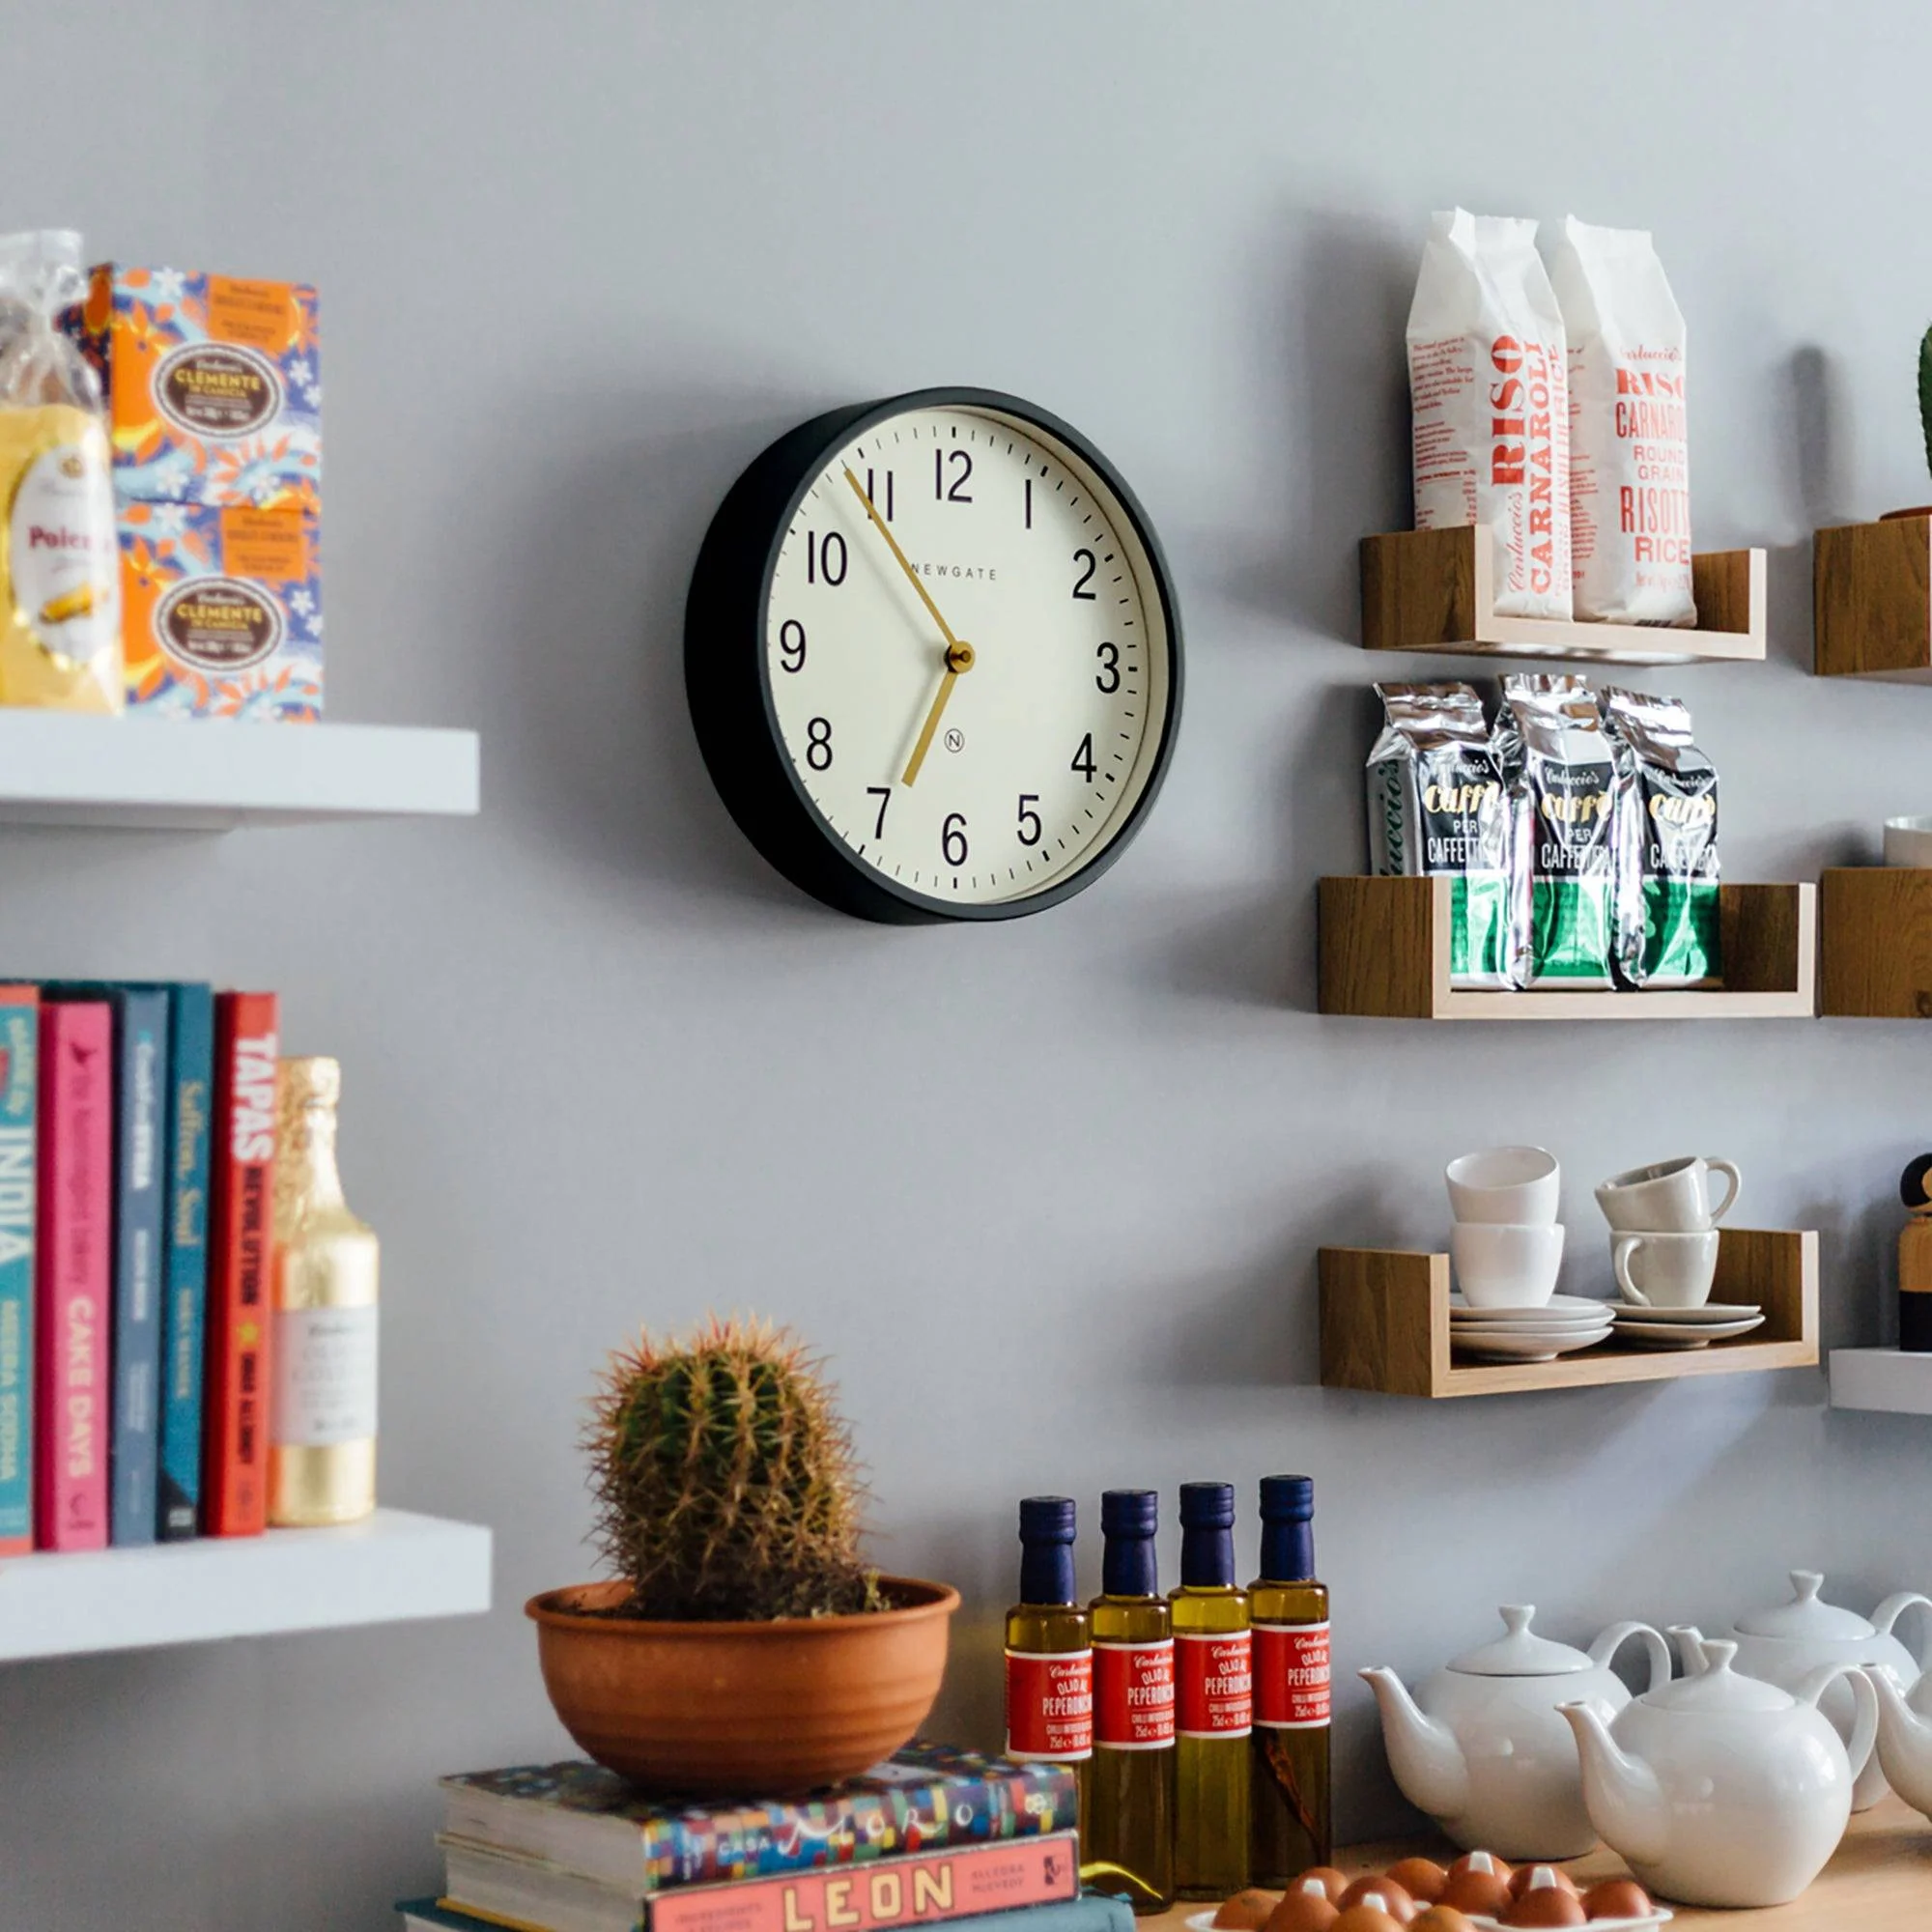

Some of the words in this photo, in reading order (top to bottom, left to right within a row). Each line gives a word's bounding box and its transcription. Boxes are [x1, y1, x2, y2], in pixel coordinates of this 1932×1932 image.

[1491, 334, 1526, 487] RISO
[935, 448, 973, 503] 12
[1523, 340, 1553, 594] CARNAROLI
[867, 469, 893, 522] 11
[1025, 478, 1032, 529] 1
[808, 530, 848, 586] 10
[1508, 491, 1525, 592] Carluccio's
[1634, 536, 1690, 565] RICE
[911, 563, 996, 581] NEWGATE
[1072, 549, 1096, 600] 2
[780, 619, 807, 672] 9
[1095, 641, 1121, 694] 3
[806, 718, 833, 771] 8
[947, 731, 962, 750] N
[1070, 732, 1097, 783] 4
[867, 786, 892, 839] 7
[1016, 794, 1042, 845] 5
[941, 812, 968, 867] 6
[232, 1033, 277, 1161] TAPAS
[0, 1126, 34, 1264] INDIA
[242, 1166, 265, 1305] REVOLUTION
[68, 1295, 94, 1387] CAKE
[68, 1395, 94, 1478] DAYS
[719, 1836, 770, 1856] CASA
[782, 1862, 953, 1932] LEON
